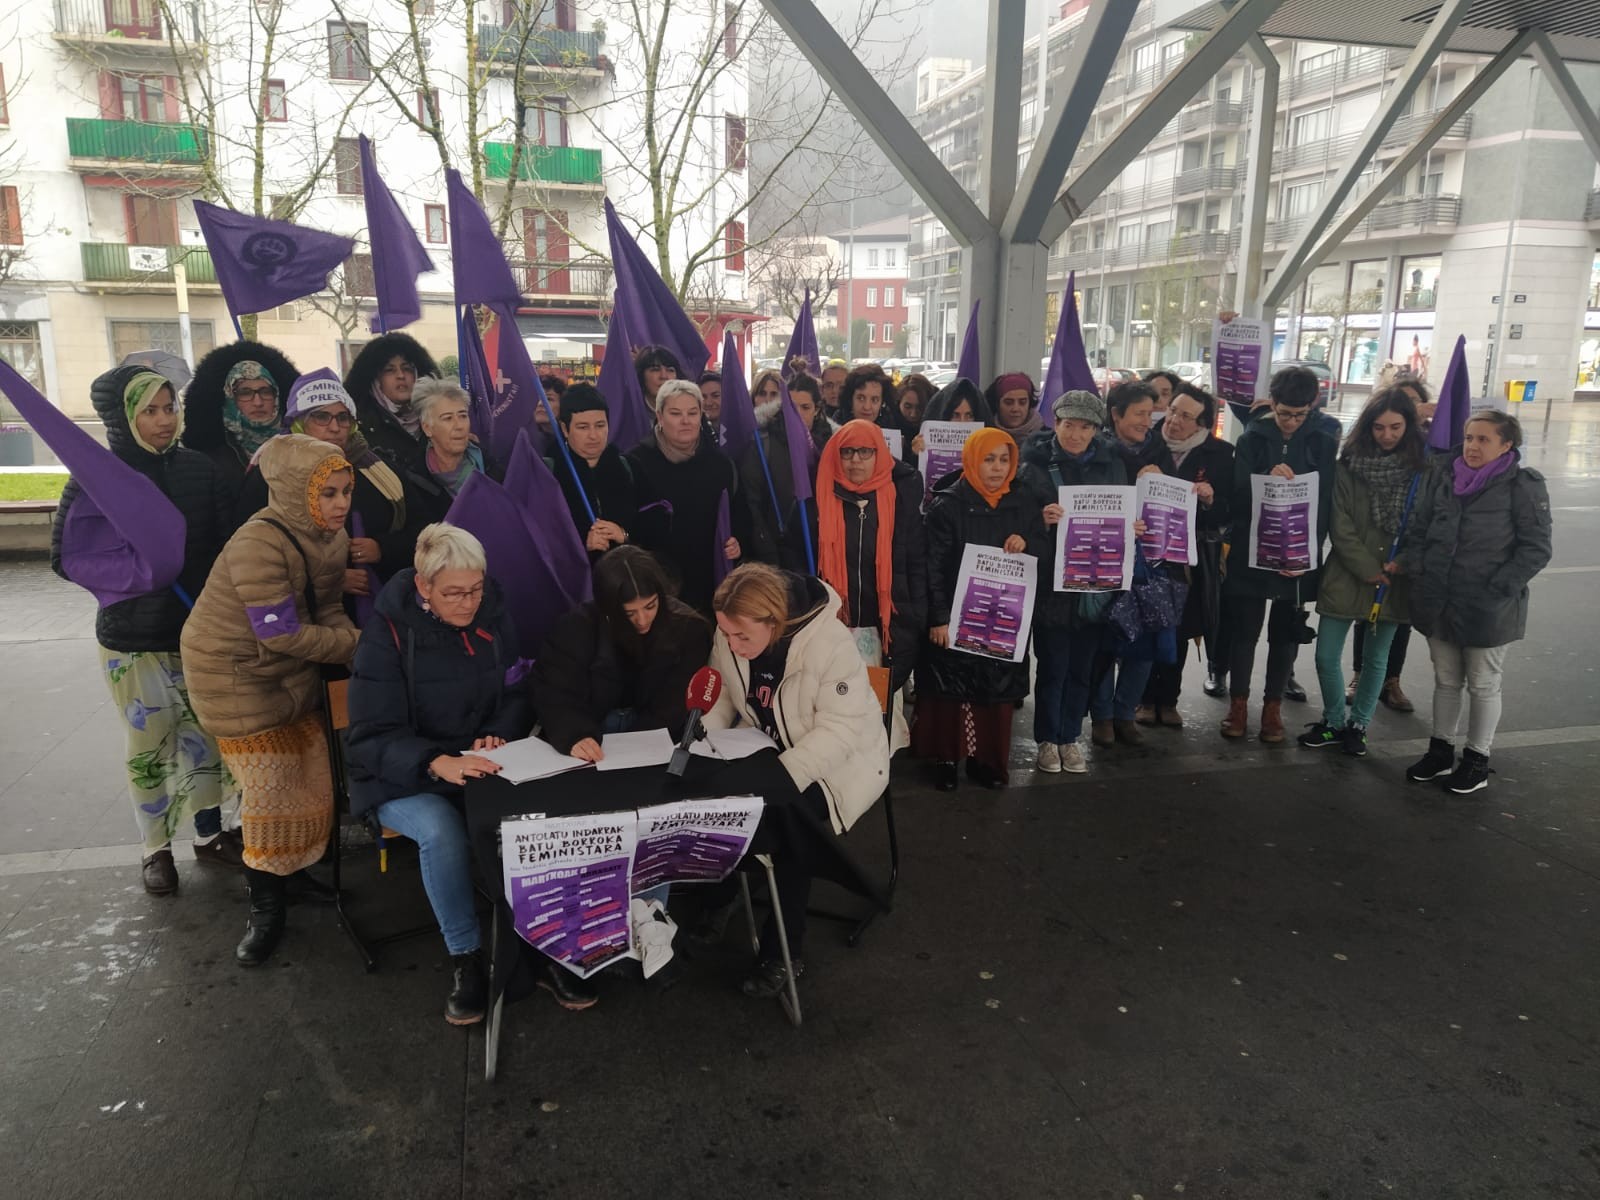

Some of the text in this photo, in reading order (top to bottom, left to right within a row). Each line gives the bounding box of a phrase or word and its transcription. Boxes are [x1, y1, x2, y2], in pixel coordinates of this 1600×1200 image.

[703, 674, 717, 702] goiena
[515, 831, 568, 844] ANTOLATU
[572, 825, 625, 838] INDARRAK
[518, 843, 622, 865] FEMINISTARA
[519, 835, 623, 854] BATU BORROKA
[521, 869, 578, 888] MARTXOAK
